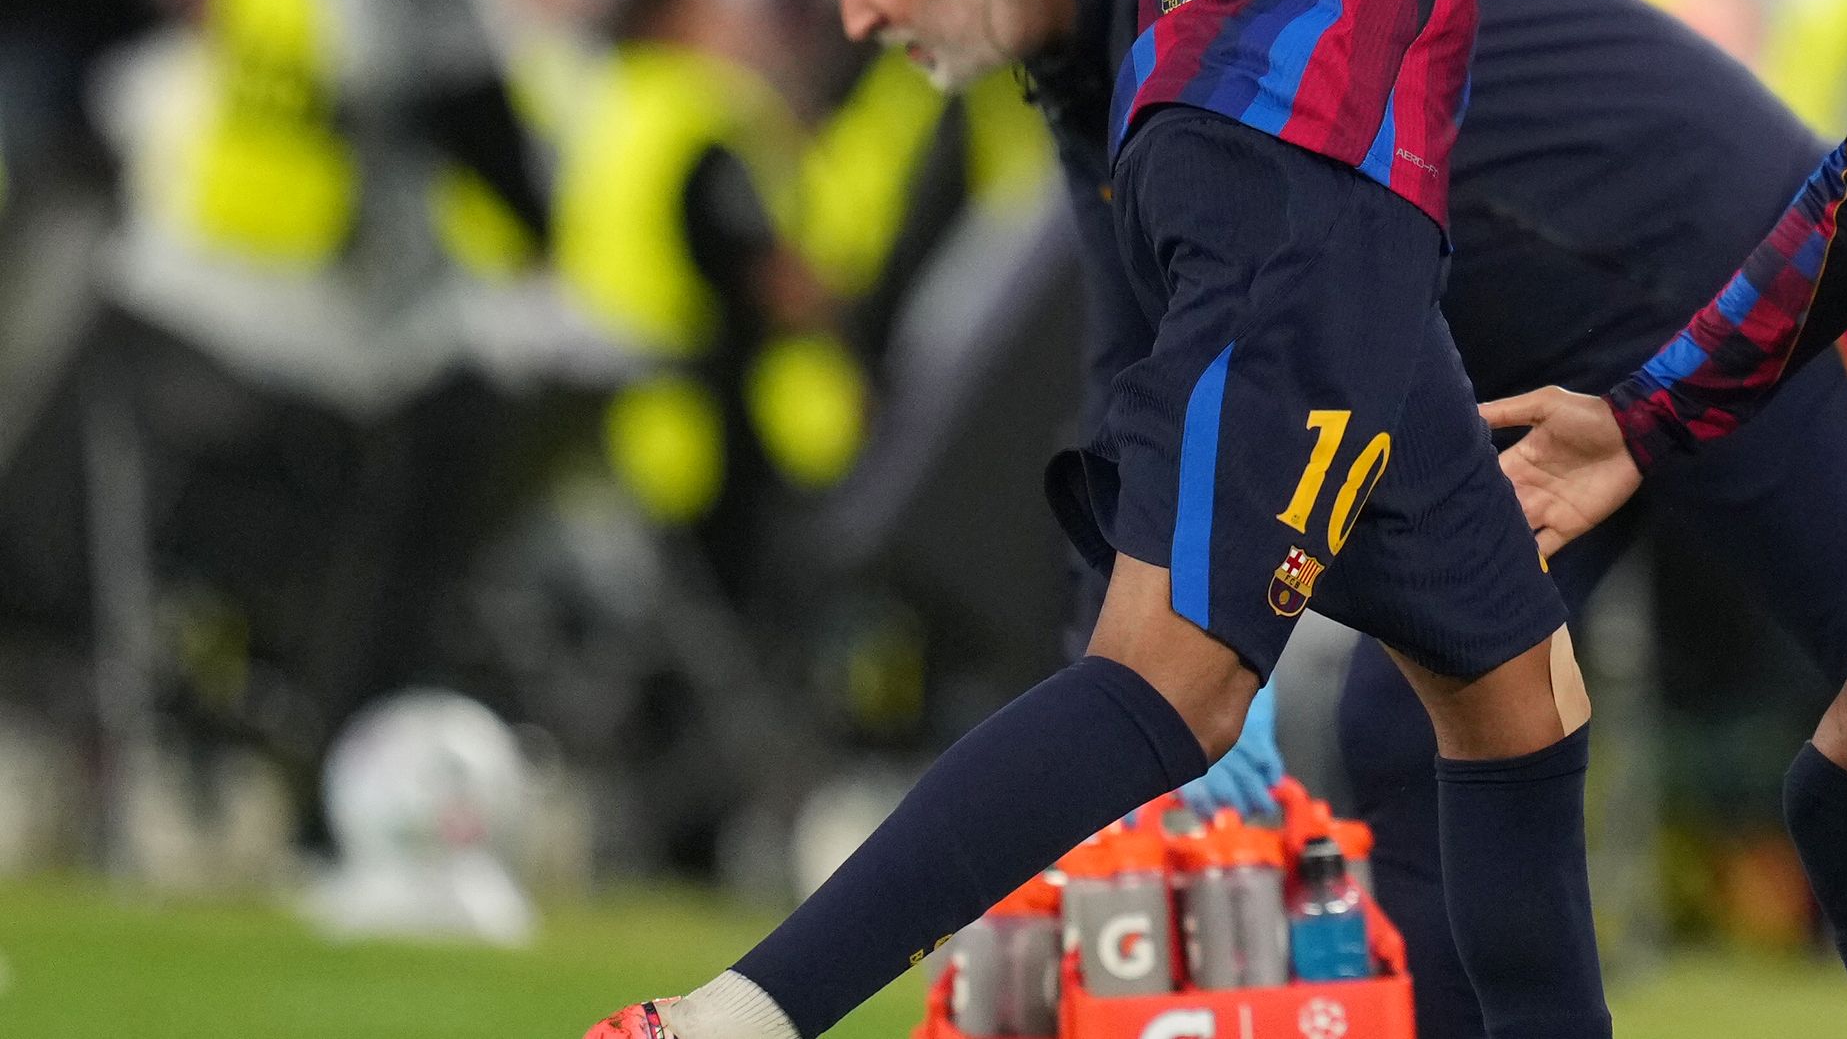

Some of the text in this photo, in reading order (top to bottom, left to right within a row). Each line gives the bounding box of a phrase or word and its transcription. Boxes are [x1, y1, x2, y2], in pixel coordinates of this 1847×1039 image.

[1275, 409, 1391, 557] 10
[1284, 575, 1300, 589] FCB
[1098, 914, 1156, 981] G
